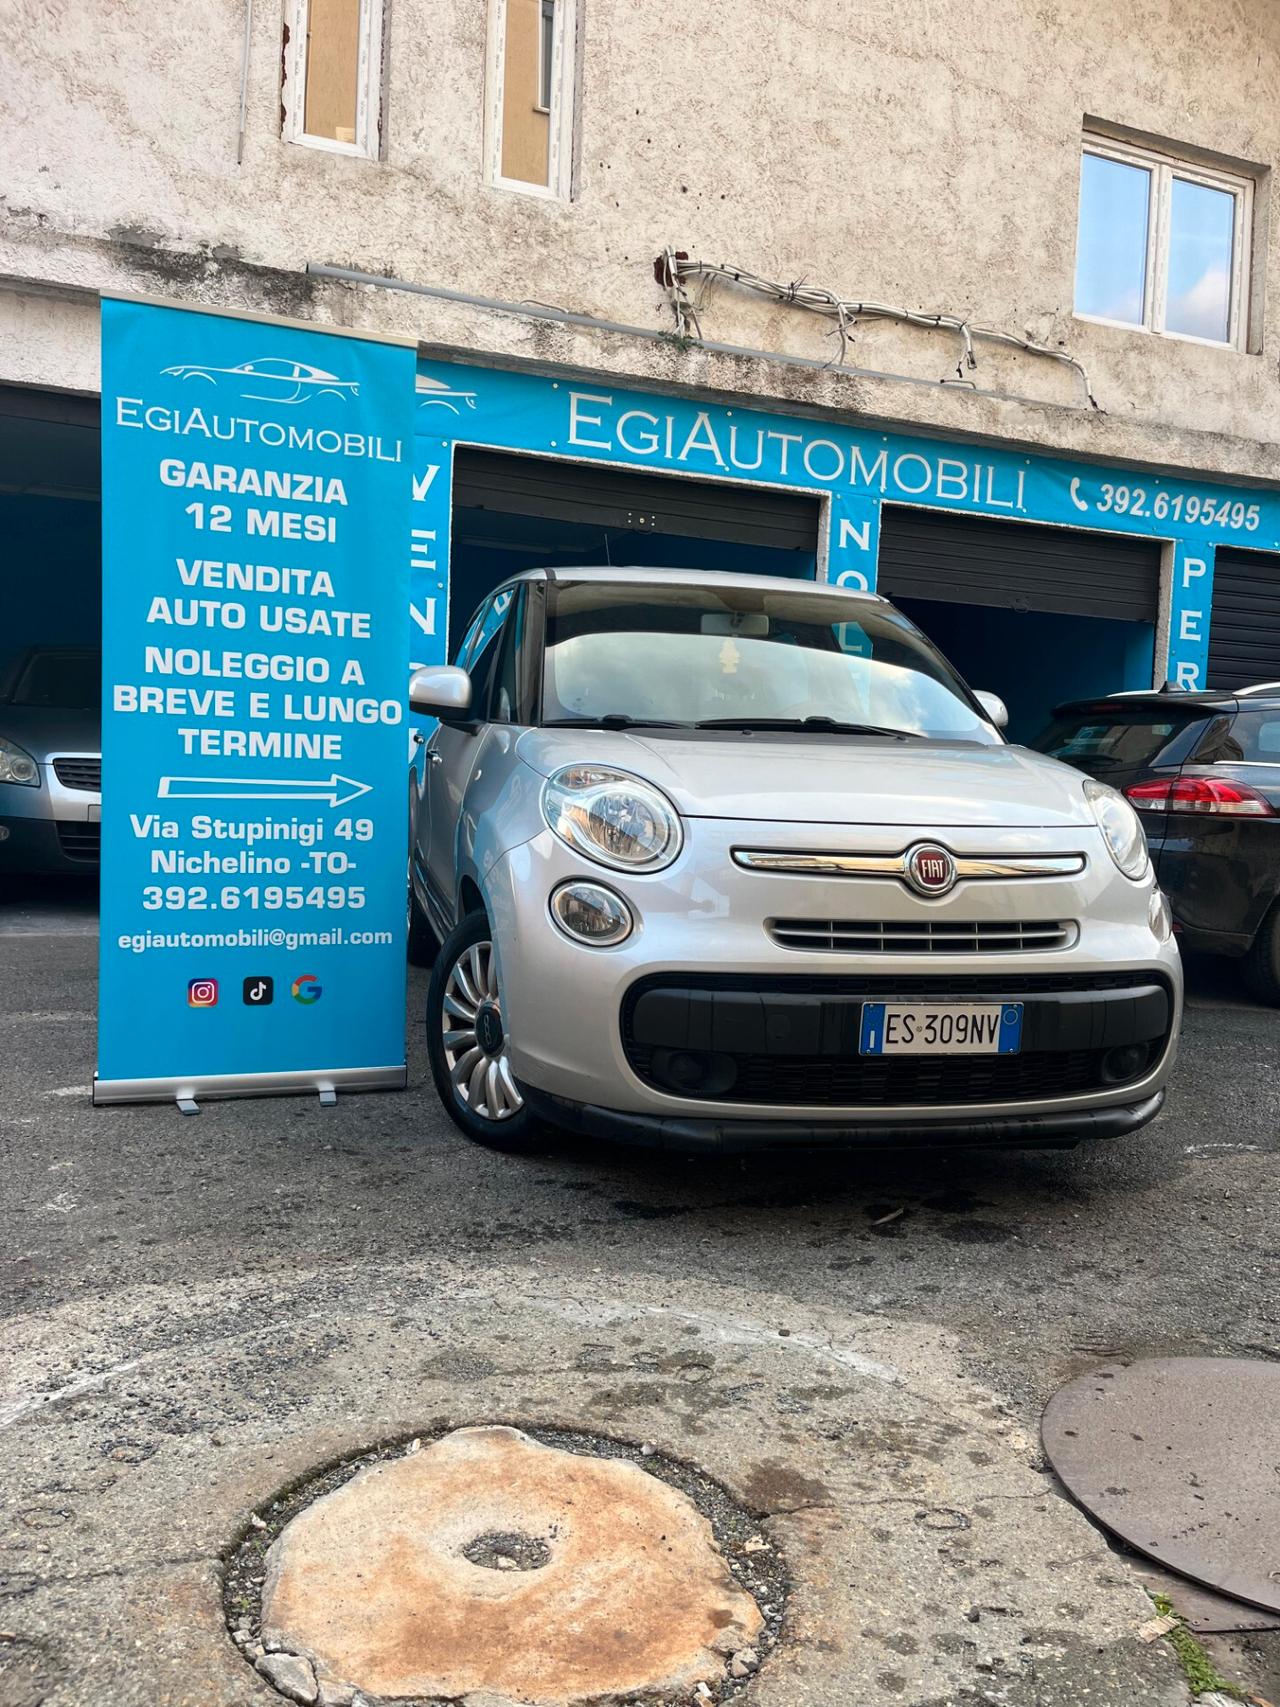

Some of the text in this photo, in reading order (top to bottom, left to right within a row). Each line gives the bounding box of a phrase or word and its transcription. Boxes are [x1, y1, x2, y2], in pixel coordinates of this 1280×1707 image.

[159, 458, 348, 506] GARANZIA
[185, 502, 336, 543] 12 MESI
[1096, 483, 1260, 532] 392.6195495
[175, 558, 335, 598] VENDITA
[146, 596, 371, 639] AUTO USATE
[145, 646, 366, 686] NOLEGGIO A
[113, 685, 402, 725] BREVE E LUNGO
[177, 728, 342, 760] TERMINE
[130, 814, 374, 846] Via Stupinigi 49
[151, 850, 356, 874] Nichelino -TO-
[921, 858, 945, 879] FIAT
[143, 886, 365, 910] 392.6195495
[118, 928, 392, 953] egiautomobili@gmail.com
